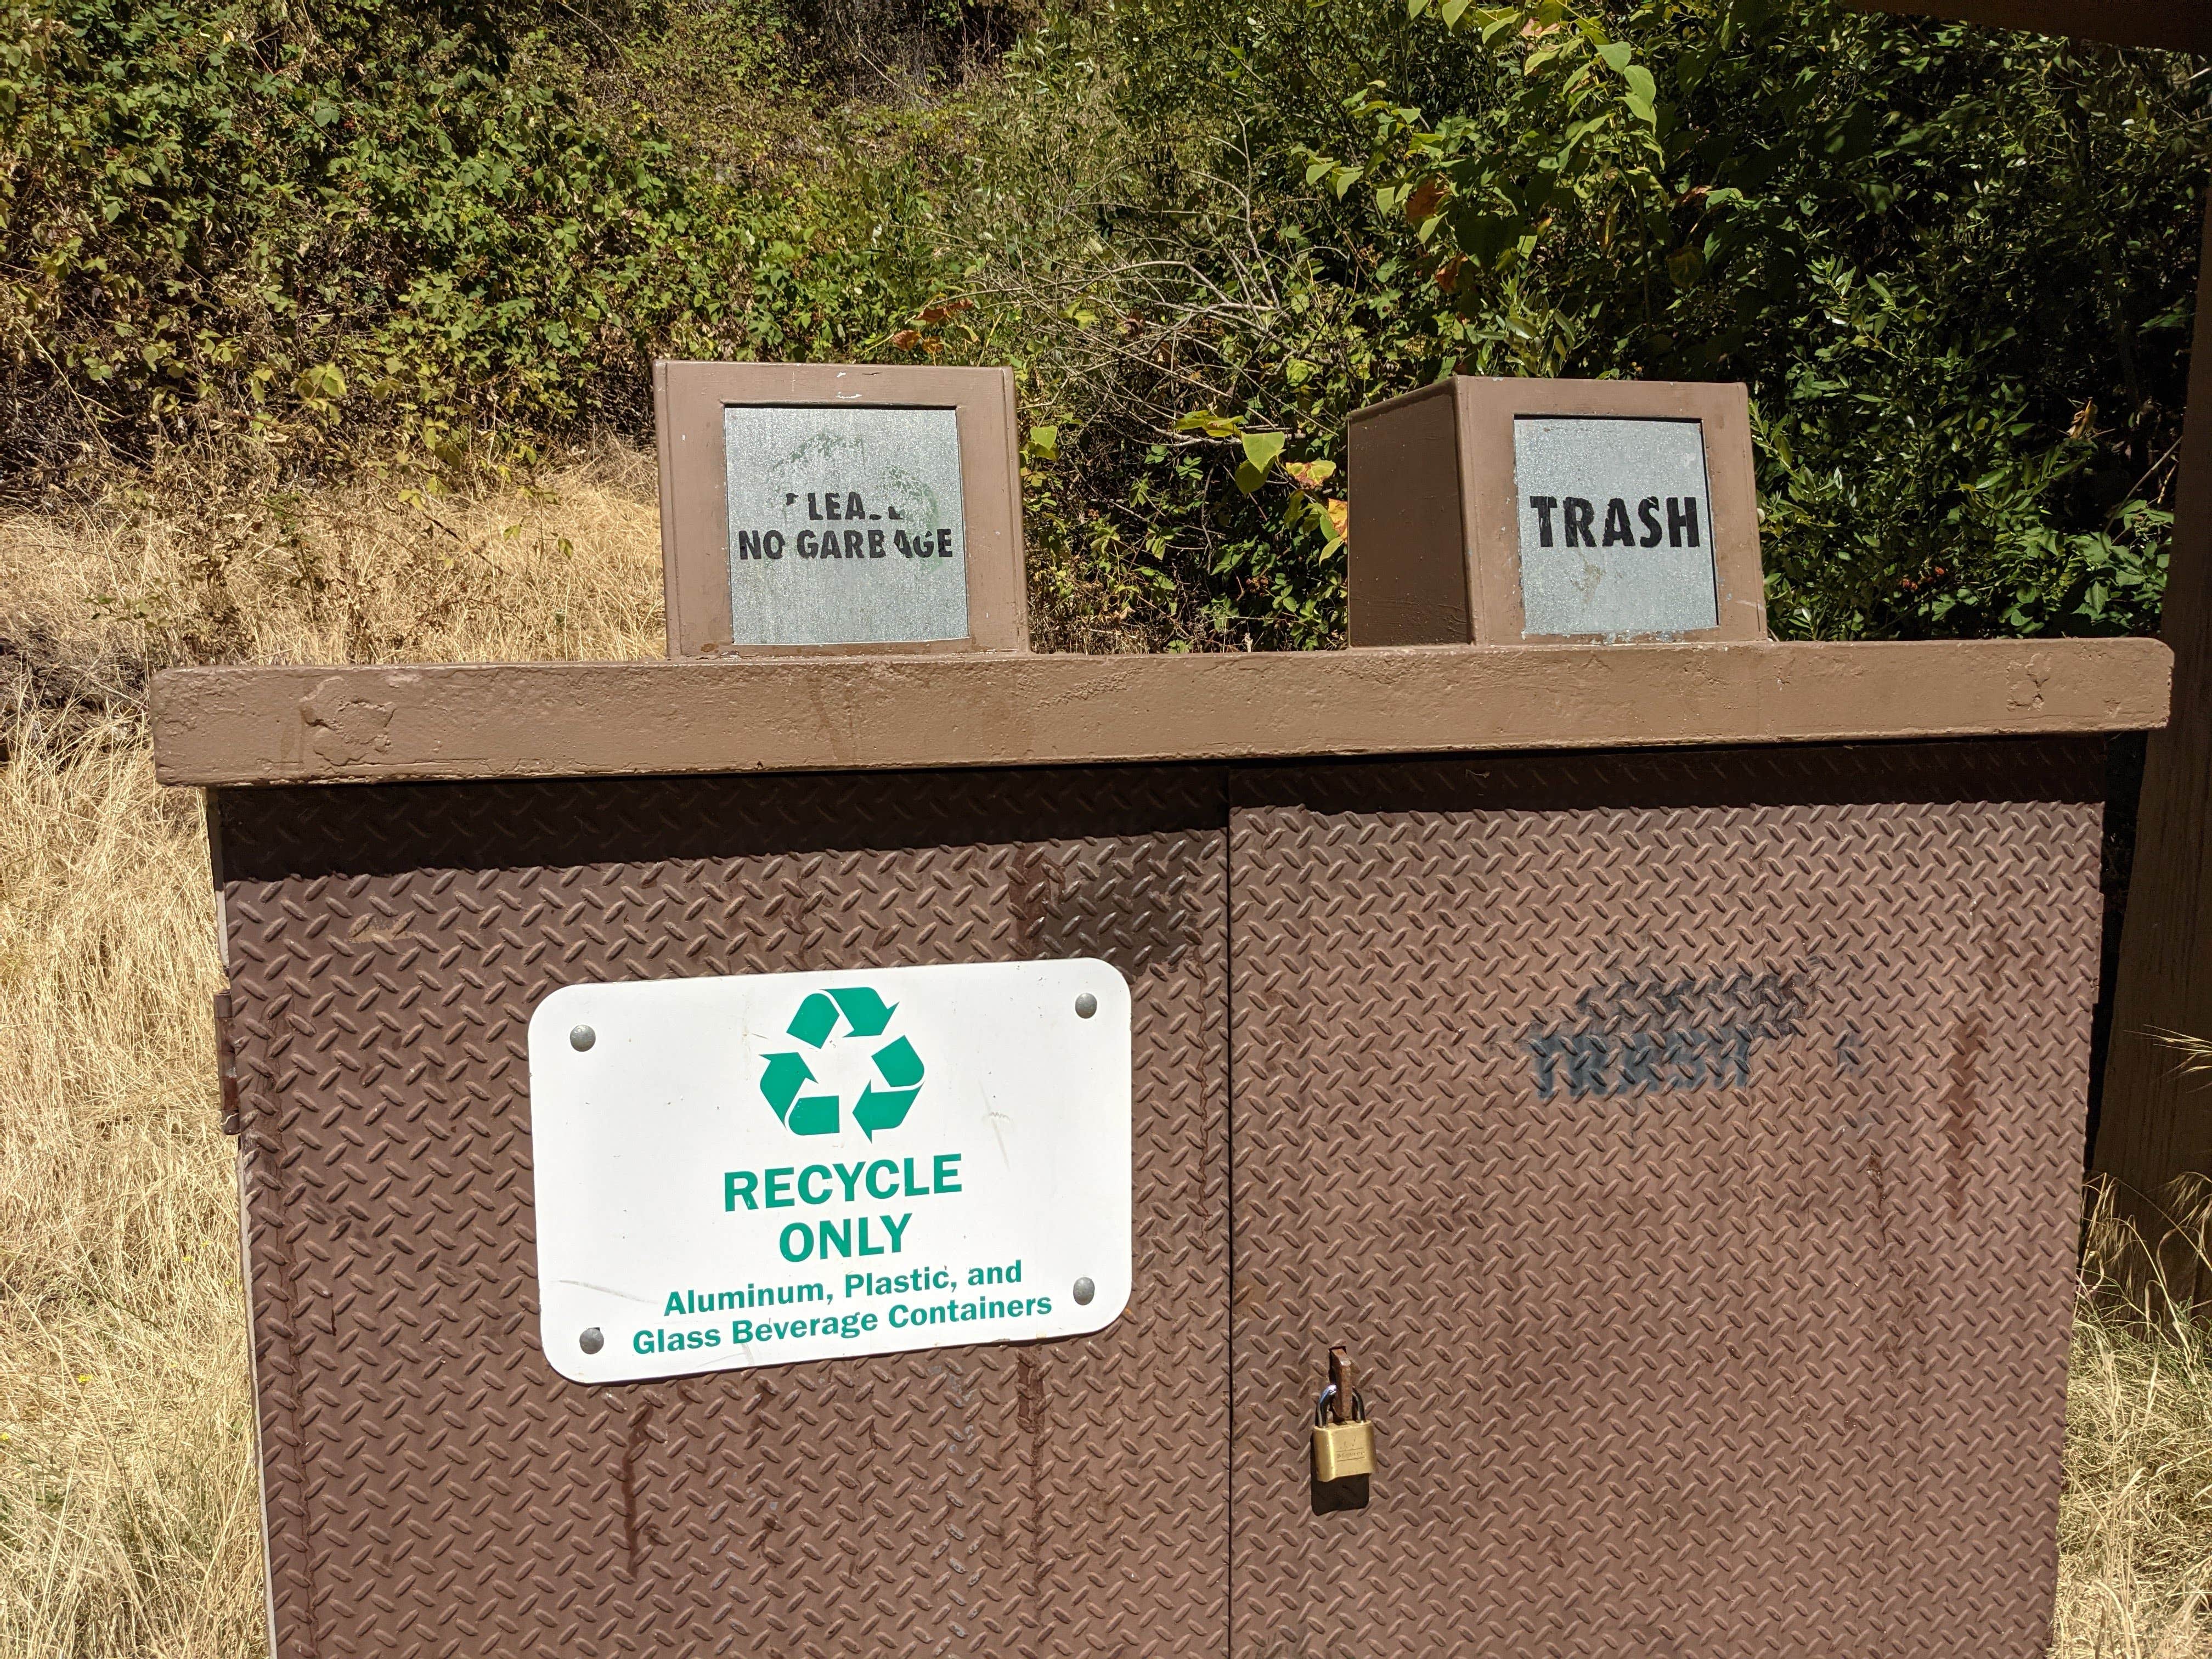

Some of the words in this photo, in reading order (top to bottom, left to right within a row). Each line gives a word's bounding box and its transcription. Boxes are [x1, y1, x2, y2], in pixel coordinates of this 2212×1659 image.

[785, 491, 904, 521] LEA
[1529, 495, 1701, 548] TRASH
[738, 529, 786, 560] NO
[796, 528, 953, 559] GARBAGE
[724, 1153, 963, 1212] RECYCLE
[778, 1212, 912, 1263] ONLY
[663, 1280, 833, 1317] Aluminum,
[844, 1266, 957, 1298] Plastic,
[967, 1259, 1022, 1286] and
[633, 1328, 721, 1355] Glass
[731, 1313, 878, 1345] Beverage
[888, 1295, 1052, 1329] Containers
